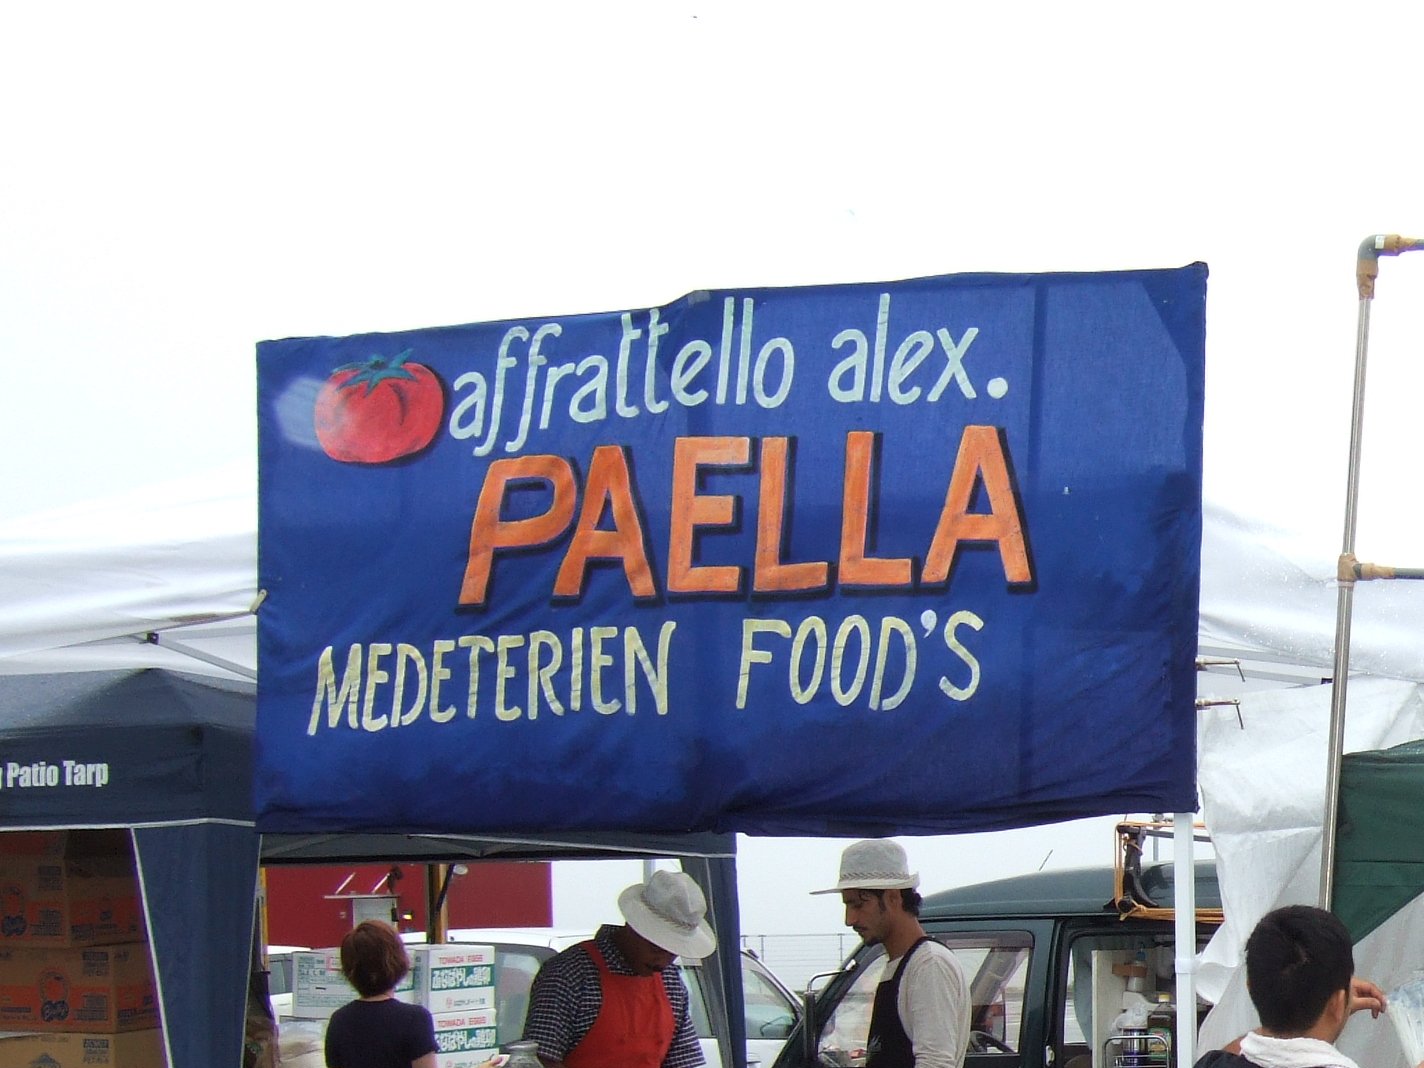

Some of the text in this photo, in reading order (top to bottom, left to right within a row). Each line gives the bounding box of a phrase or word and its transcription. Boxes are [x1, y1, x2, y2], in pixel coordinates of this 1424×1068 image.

[448, 293, 1010, 457] affrattello alex.
[457, 425, 1035, 608] PAELLA
[306, 609, 985, 737] MEDETERIEN FOOD'S
[6, 761, 60, 788] Patio
[62, 759, 110, 788] Tarp
